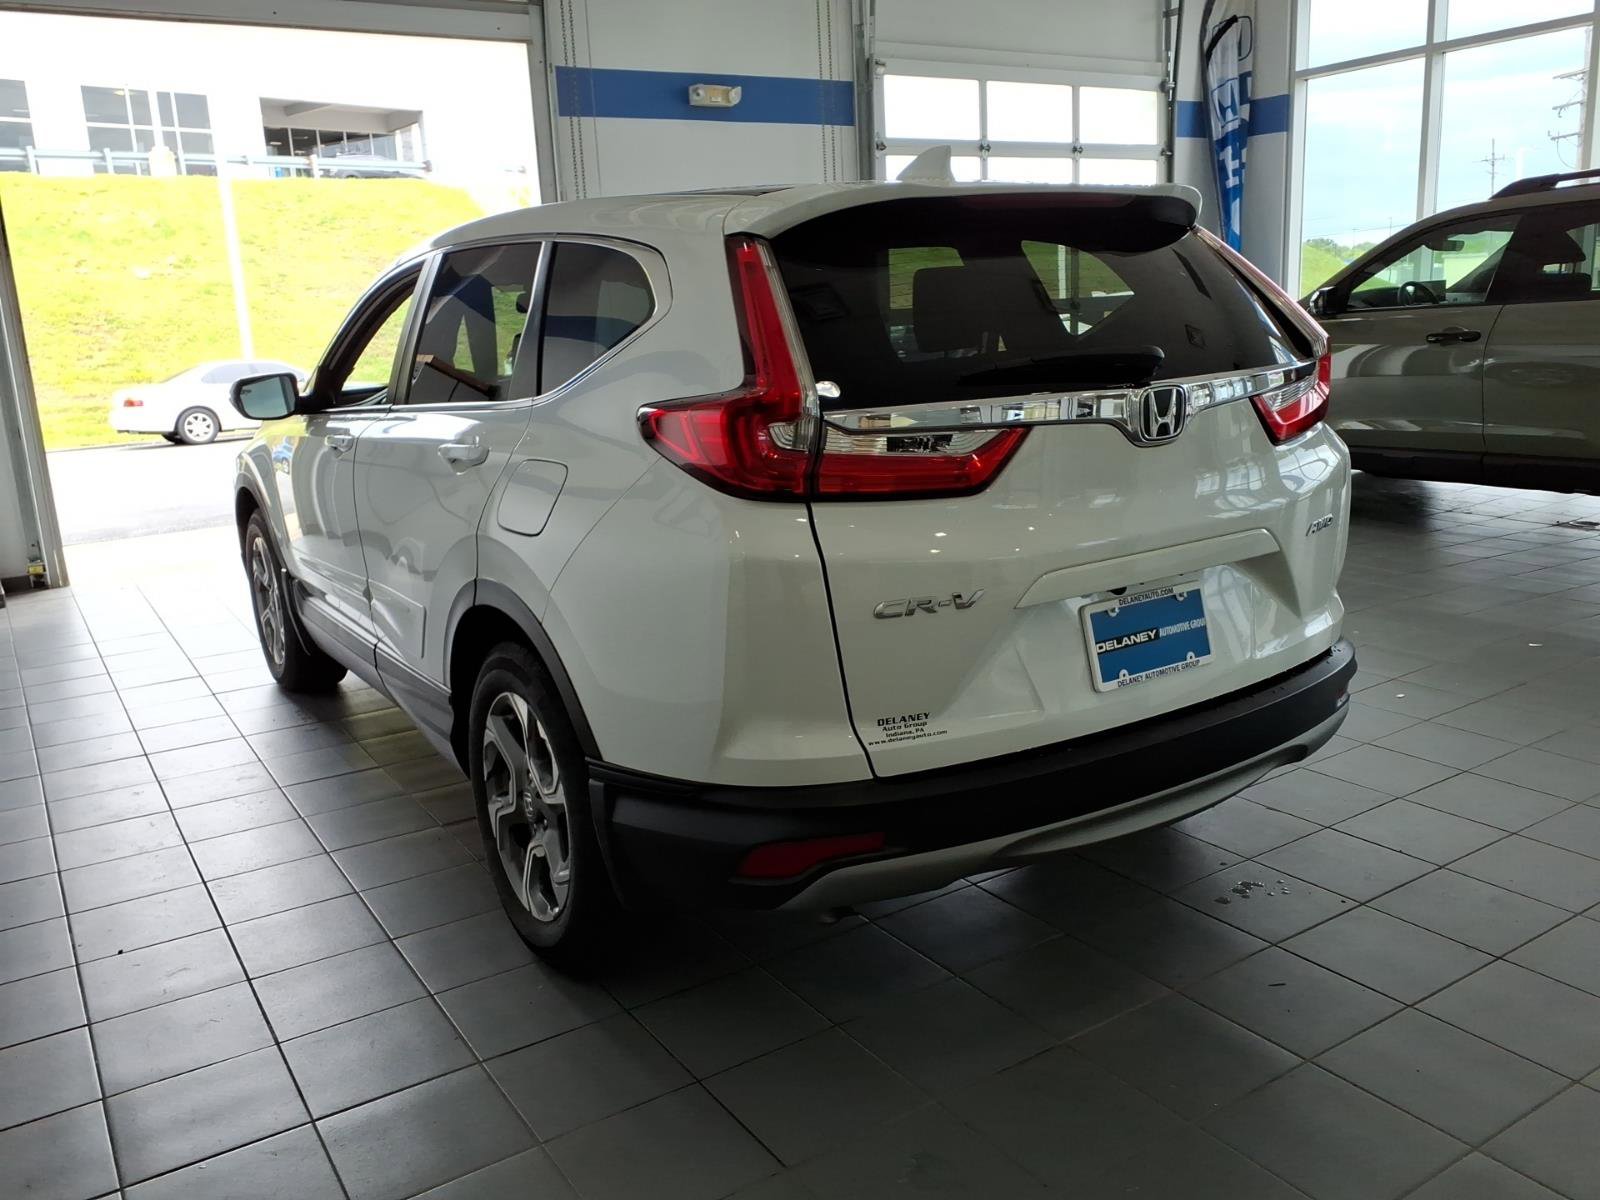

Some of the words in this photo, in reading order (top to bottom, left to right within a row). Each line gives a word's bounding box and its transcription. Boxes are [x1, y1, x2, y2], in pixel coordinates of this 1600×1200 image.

[873, 588, 985, 619] CR-V
[1096, 628, 1157, 653] DELANEY
[1159, 621, 1191, 638] AUTOMOTIVE
[1117, 675, 1143, 688] DELANEY
[1144, 664, 1181, 679] AUTOMOTIVE
[1181, 659, 1201, 670] GROUP
[877, 712, 931, 727] DELANEY
[882, 724, 902, 732] Auto
[904, 721, 928, 730] Group
